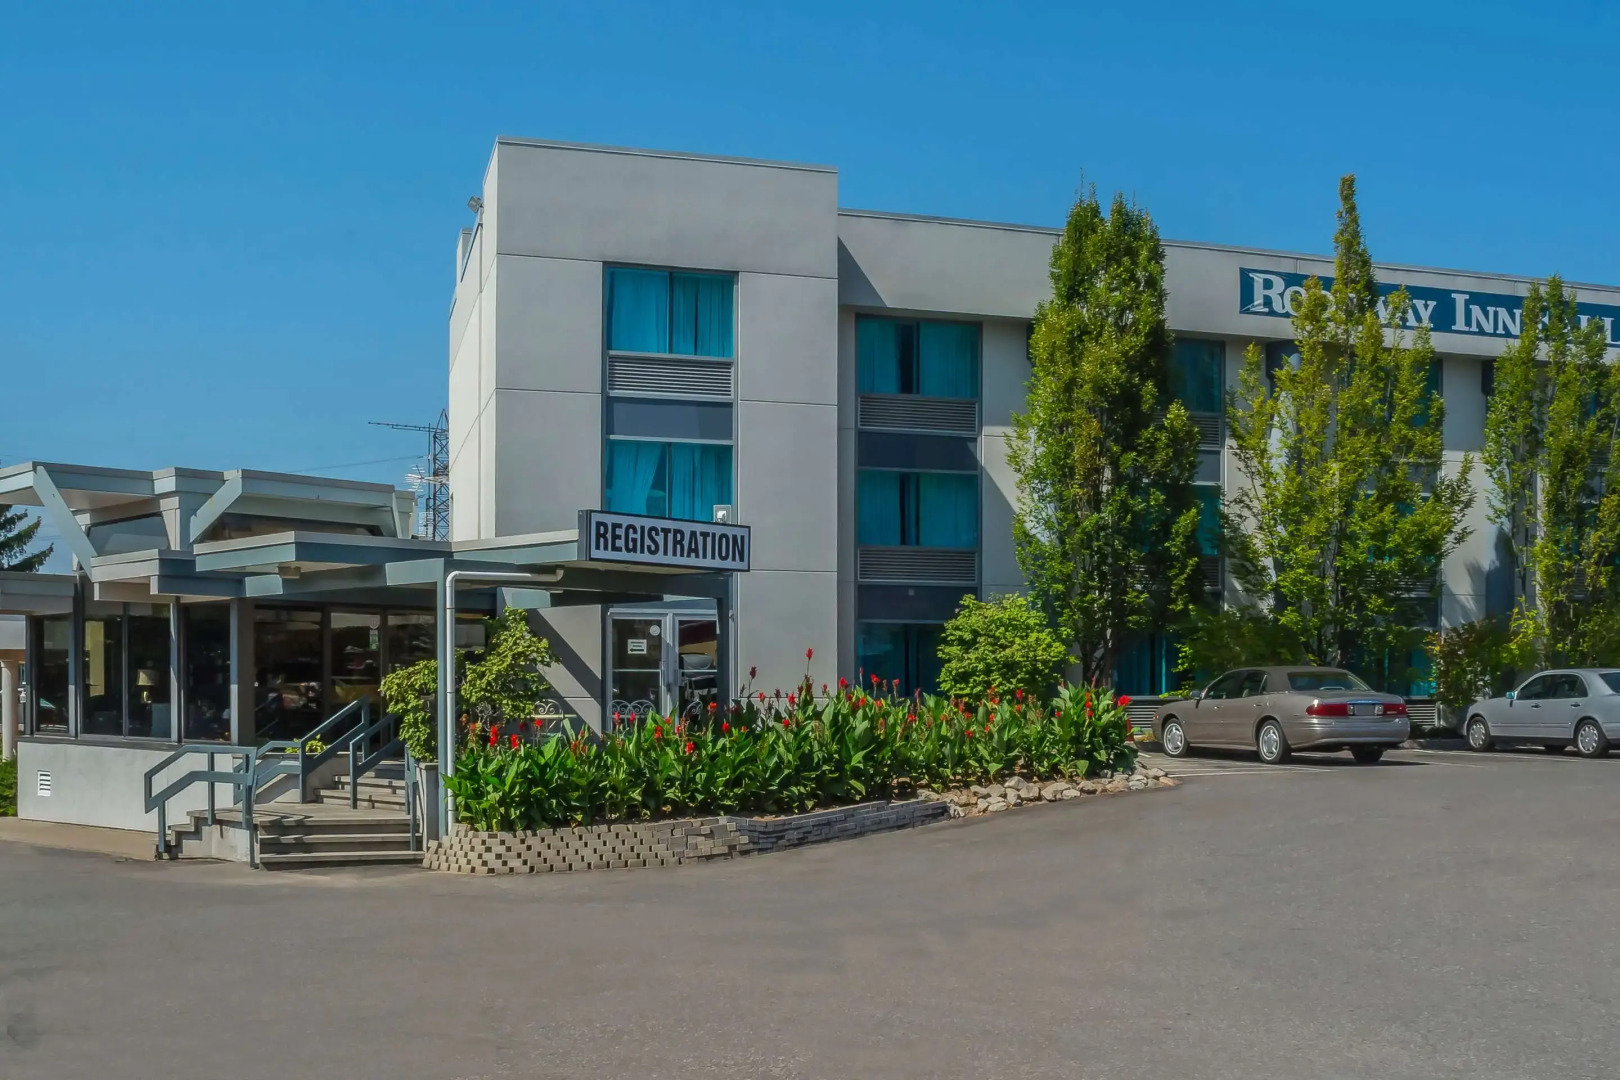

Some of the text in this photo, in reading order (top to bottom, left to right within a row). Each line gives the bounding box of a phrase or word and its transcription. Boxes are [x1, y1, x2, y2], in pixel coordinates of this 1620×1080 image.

[1248, 272, 1437, 328] ROAY
[1451, 293, 1522, 336] INN
[595, 520, 745, 563] REGISTRATION
